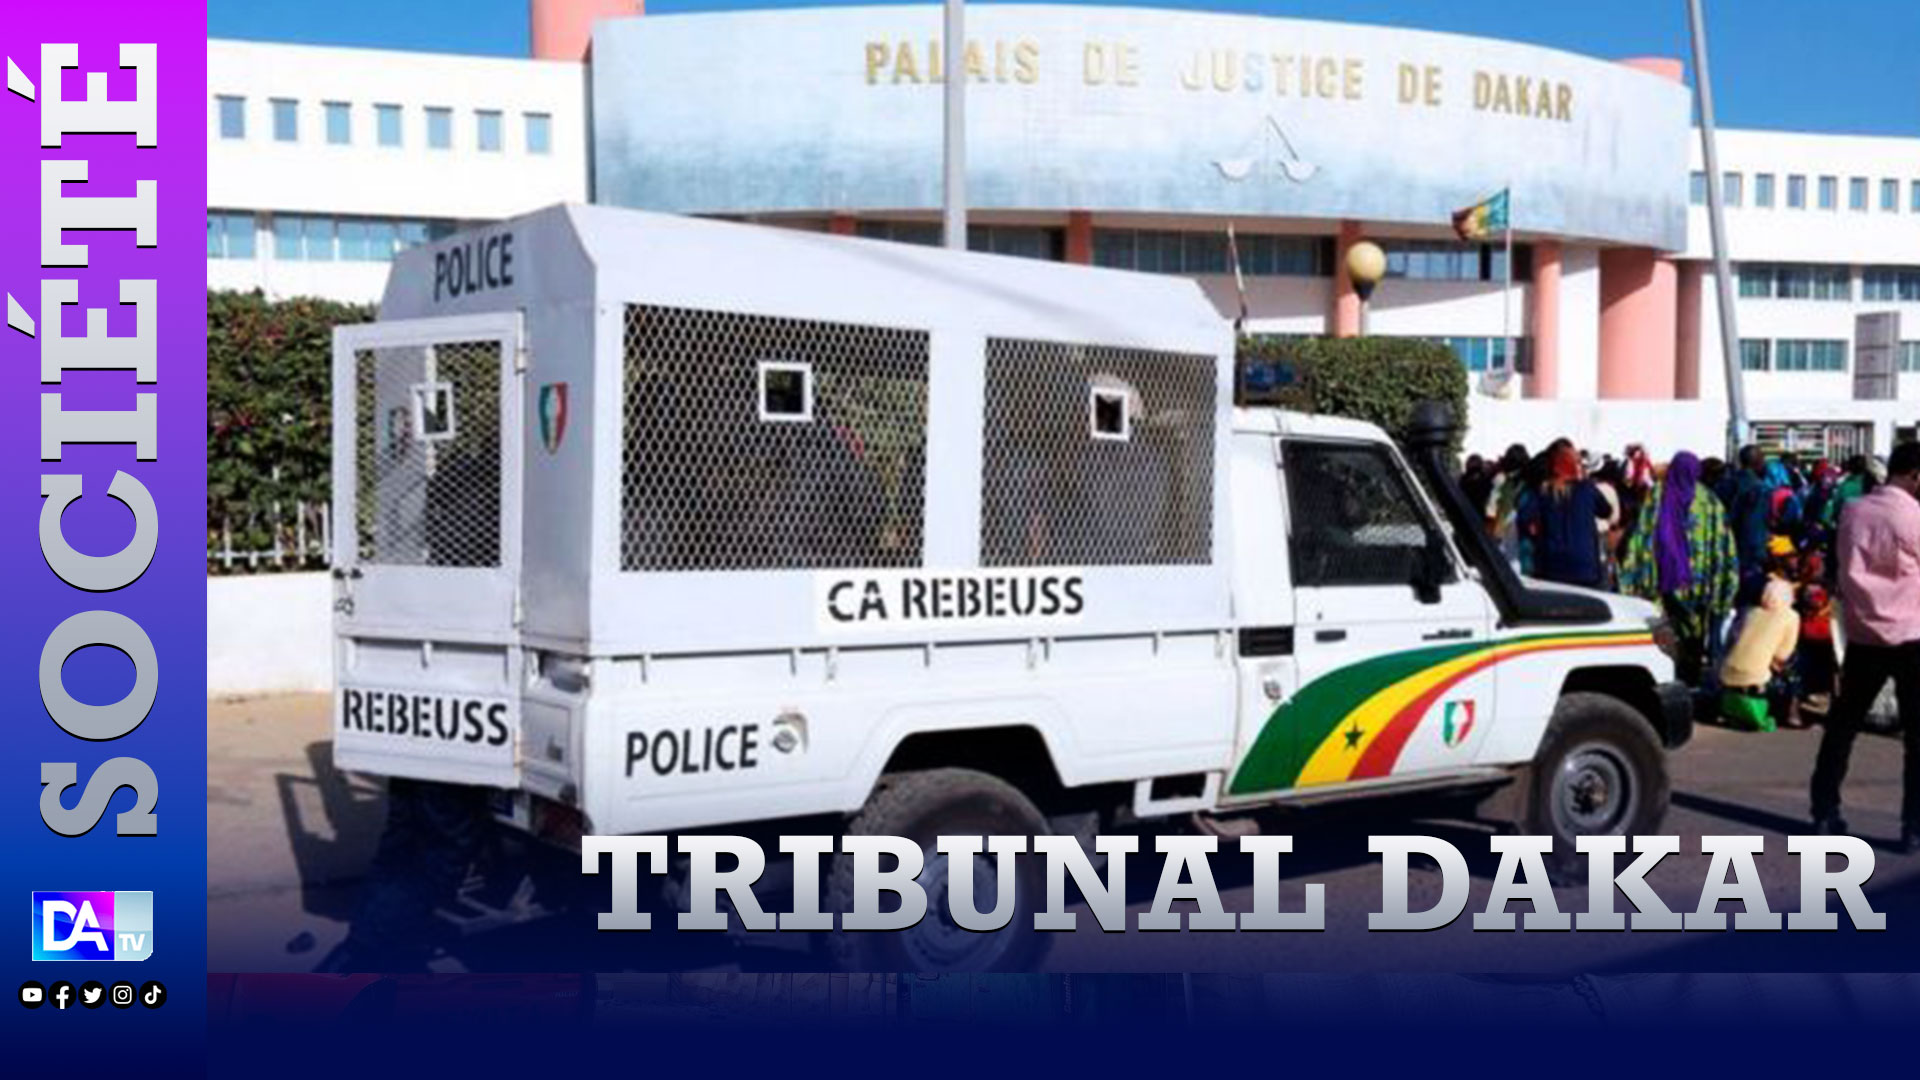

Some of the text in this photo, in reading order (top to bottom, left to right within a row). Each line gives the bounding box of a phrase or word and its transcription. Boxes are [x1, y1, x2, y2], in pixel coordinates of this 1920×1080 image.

[865, 41, 1572, 121] PALAIS DE JUSTICE DE DAKAR
[433, 233, 514, 301] POLICE
[828, 575, 1084, 621] CA REBEUSS
[342, 688, 508, 747] REBEUSS
[625, 723, 759, 777] POLICE
